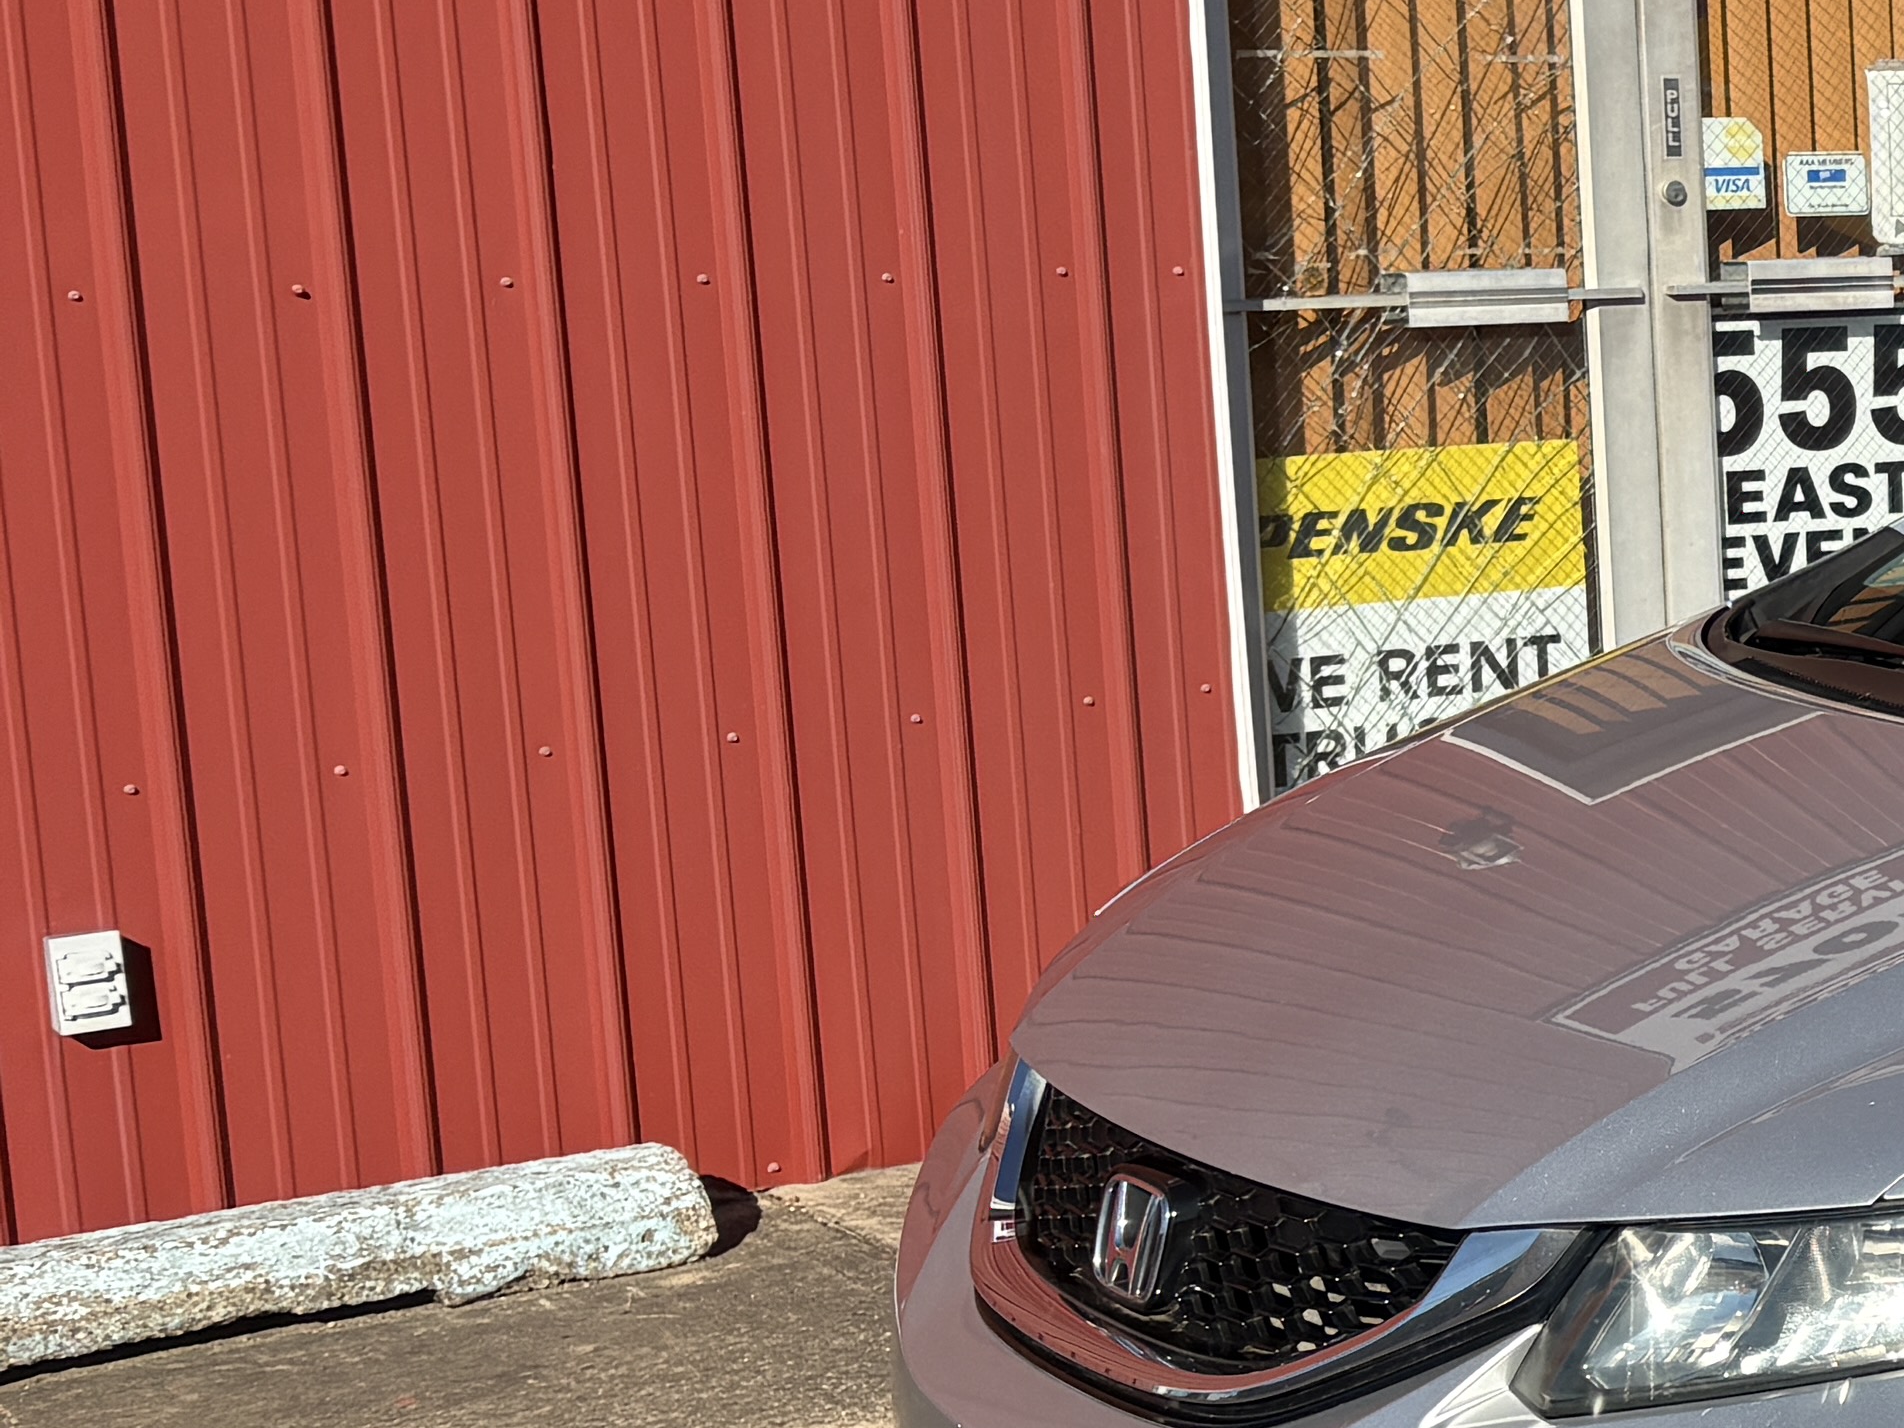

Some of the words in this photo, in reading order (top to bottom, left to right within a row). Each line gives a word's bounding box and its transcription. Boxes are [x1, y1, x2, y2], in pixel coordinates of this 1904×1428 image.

[1665, 89, 1681, 147] PULL
[1714, 178, 1751, 194] VISA
[1260, 496, 1540, 561] PENSKE
[1378, 633, 1563, 703] RENT
